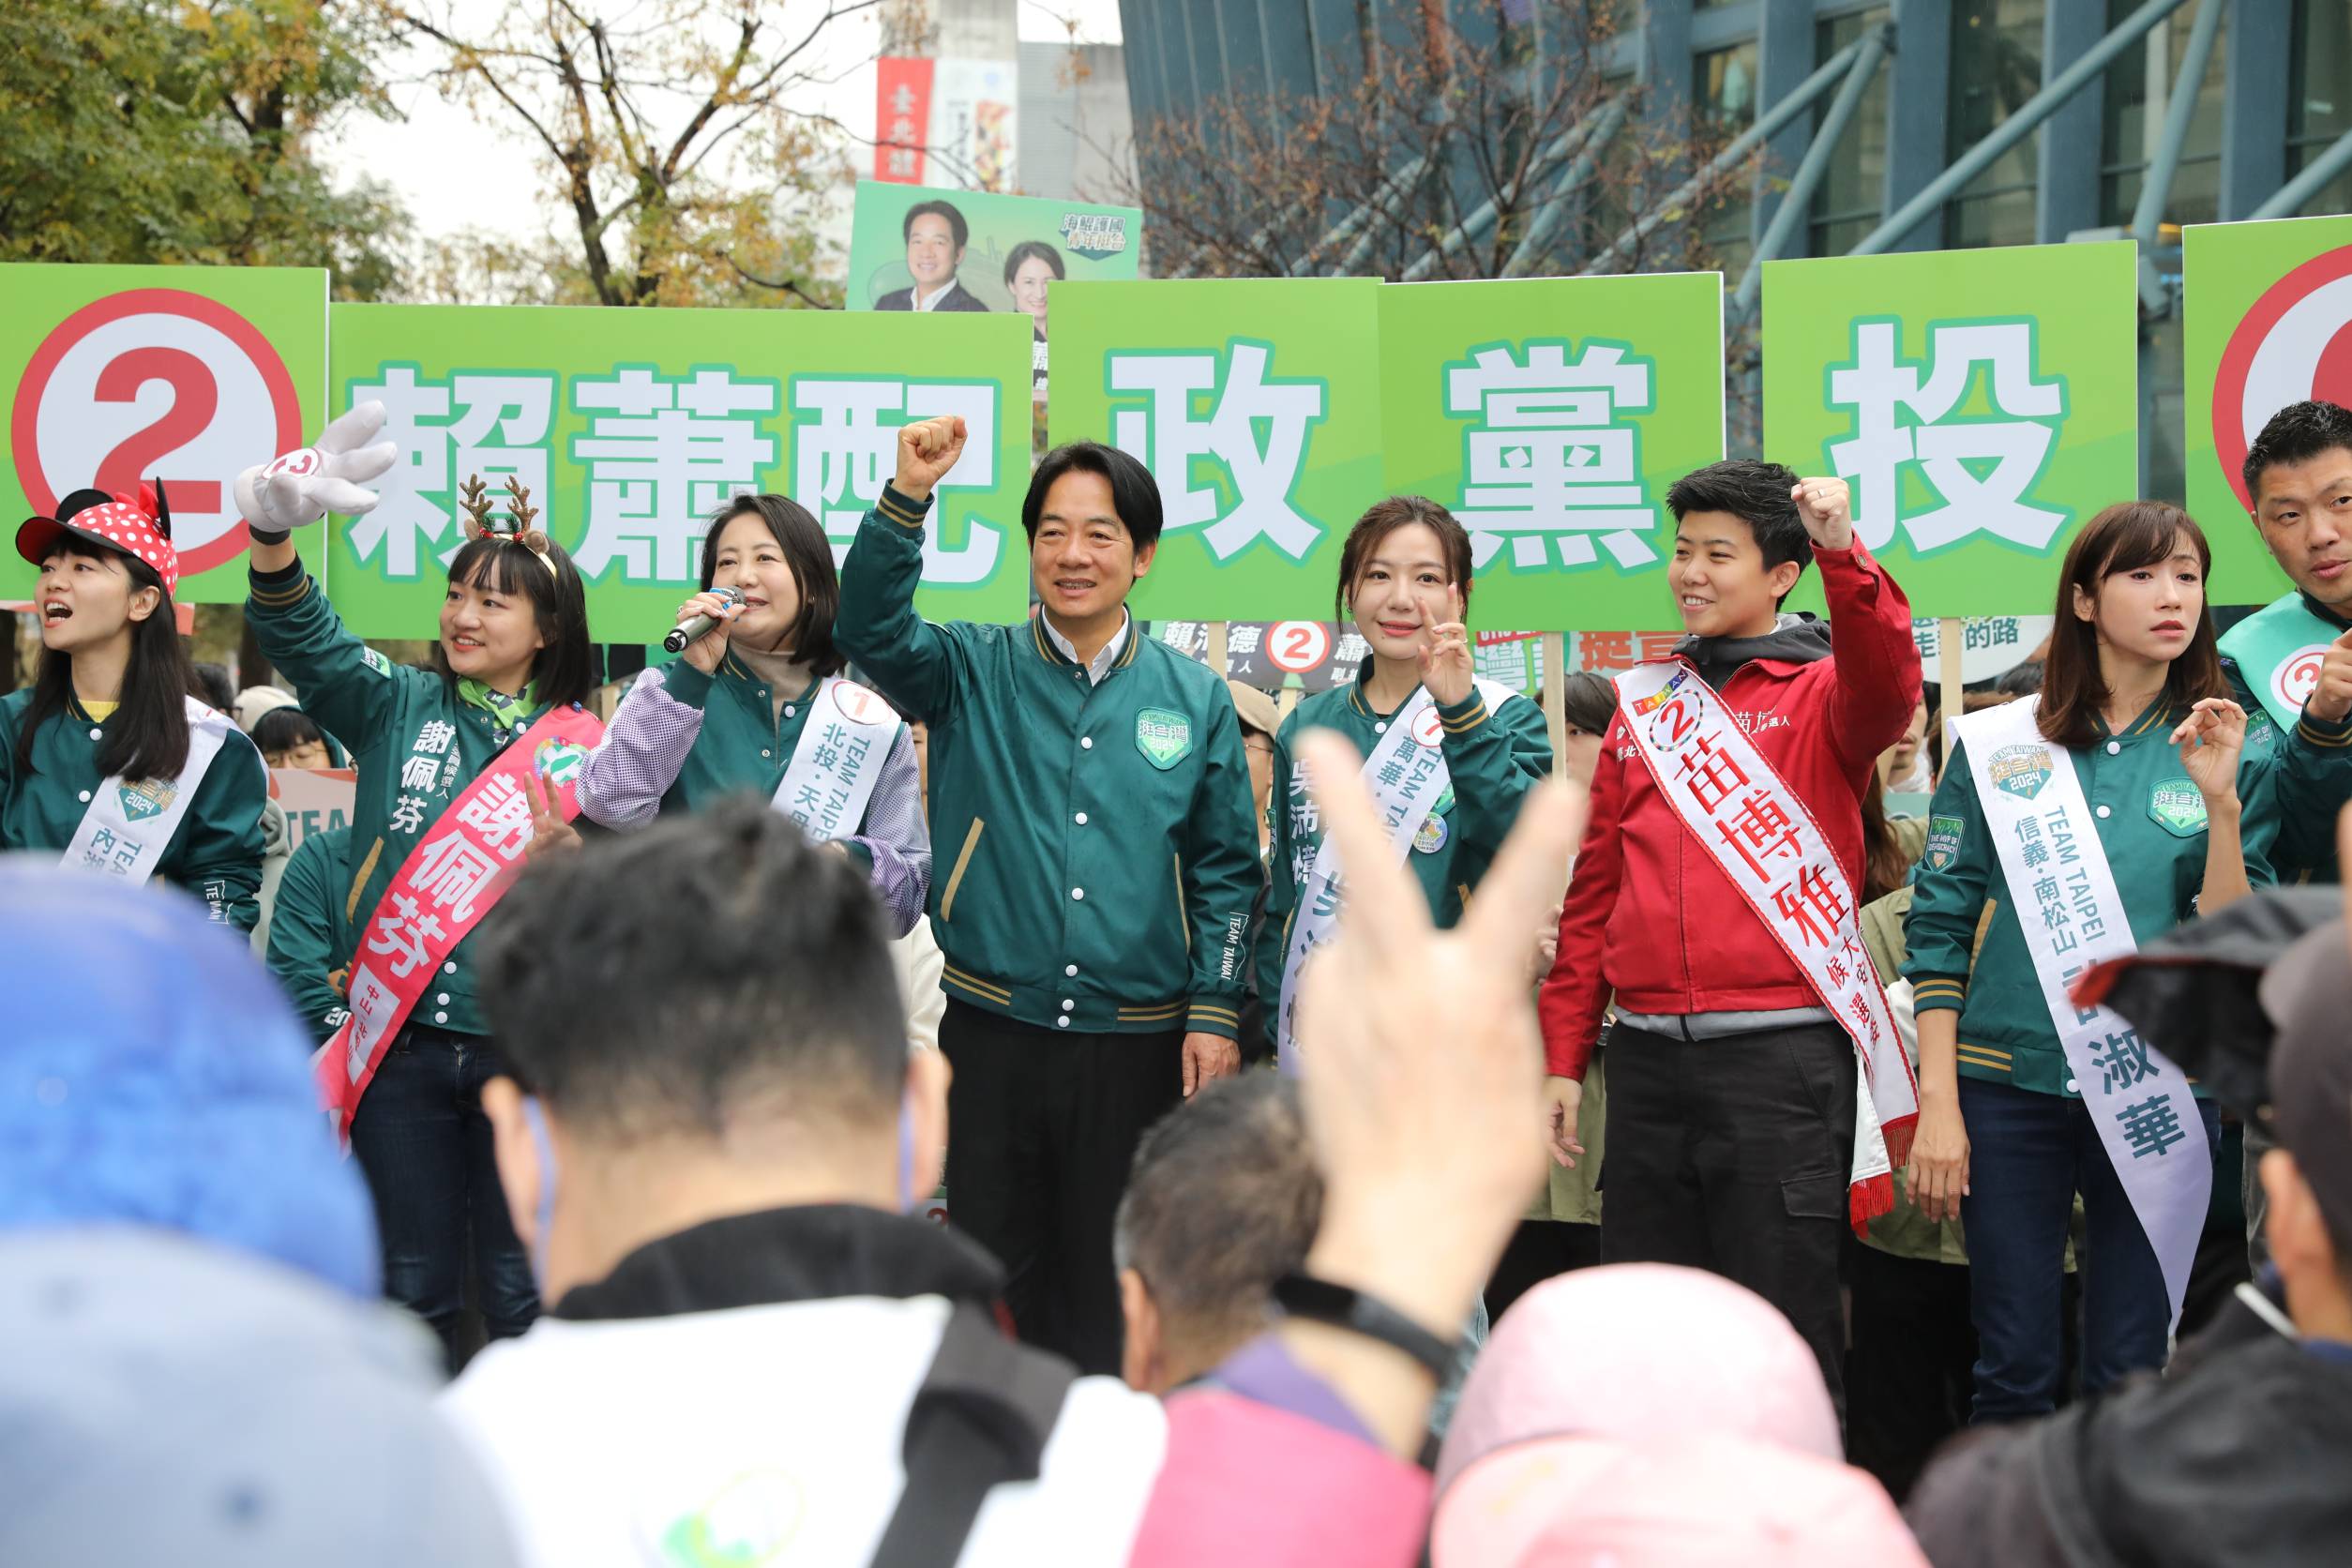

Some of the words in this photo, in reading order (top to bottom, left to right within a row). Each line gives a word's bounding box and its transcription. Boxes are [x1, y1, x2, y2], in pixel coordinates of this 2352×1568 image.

[94, 346, 221, 514] 2
[1111, 343, 1321, 561] 政
[1829, 323, 2067, 552] 投
[348, 367, 1000, 584] 賴蕭配
[1449, 344, 1658, 569] 黨
[1283, 627, 1312, 659] 2
[1334, 633, 1373, 662] 蕭
[853, 691, 870, 717] 1
[1660, 700, 1695, 744] 2
[389, 719, 457, 834] 謝佩芬
[837, 736, 871, 787] TEAM
[1399, 749, 1443, 801] TEAM
[2009, 772, 2042, 791] 2024
[125, 792, 156, 814] 2024
[812, 788, 850, 841] TAIPE
[285, 809, 346, 851] TEA
[1673, 730, 1850, 948] 苗博雅
[109, 841, 143, 875] TEA
[368, 772, 536, 979] 謝佩芬
[2044, 806, 2081, 865] TEAM
[2065, 867, 2106, 942] TAIPEI
[205, 886, 219, 899] TE
[1227, 917, 1241, 945] TEAM
[324, 1006, 353, 1027] 20
